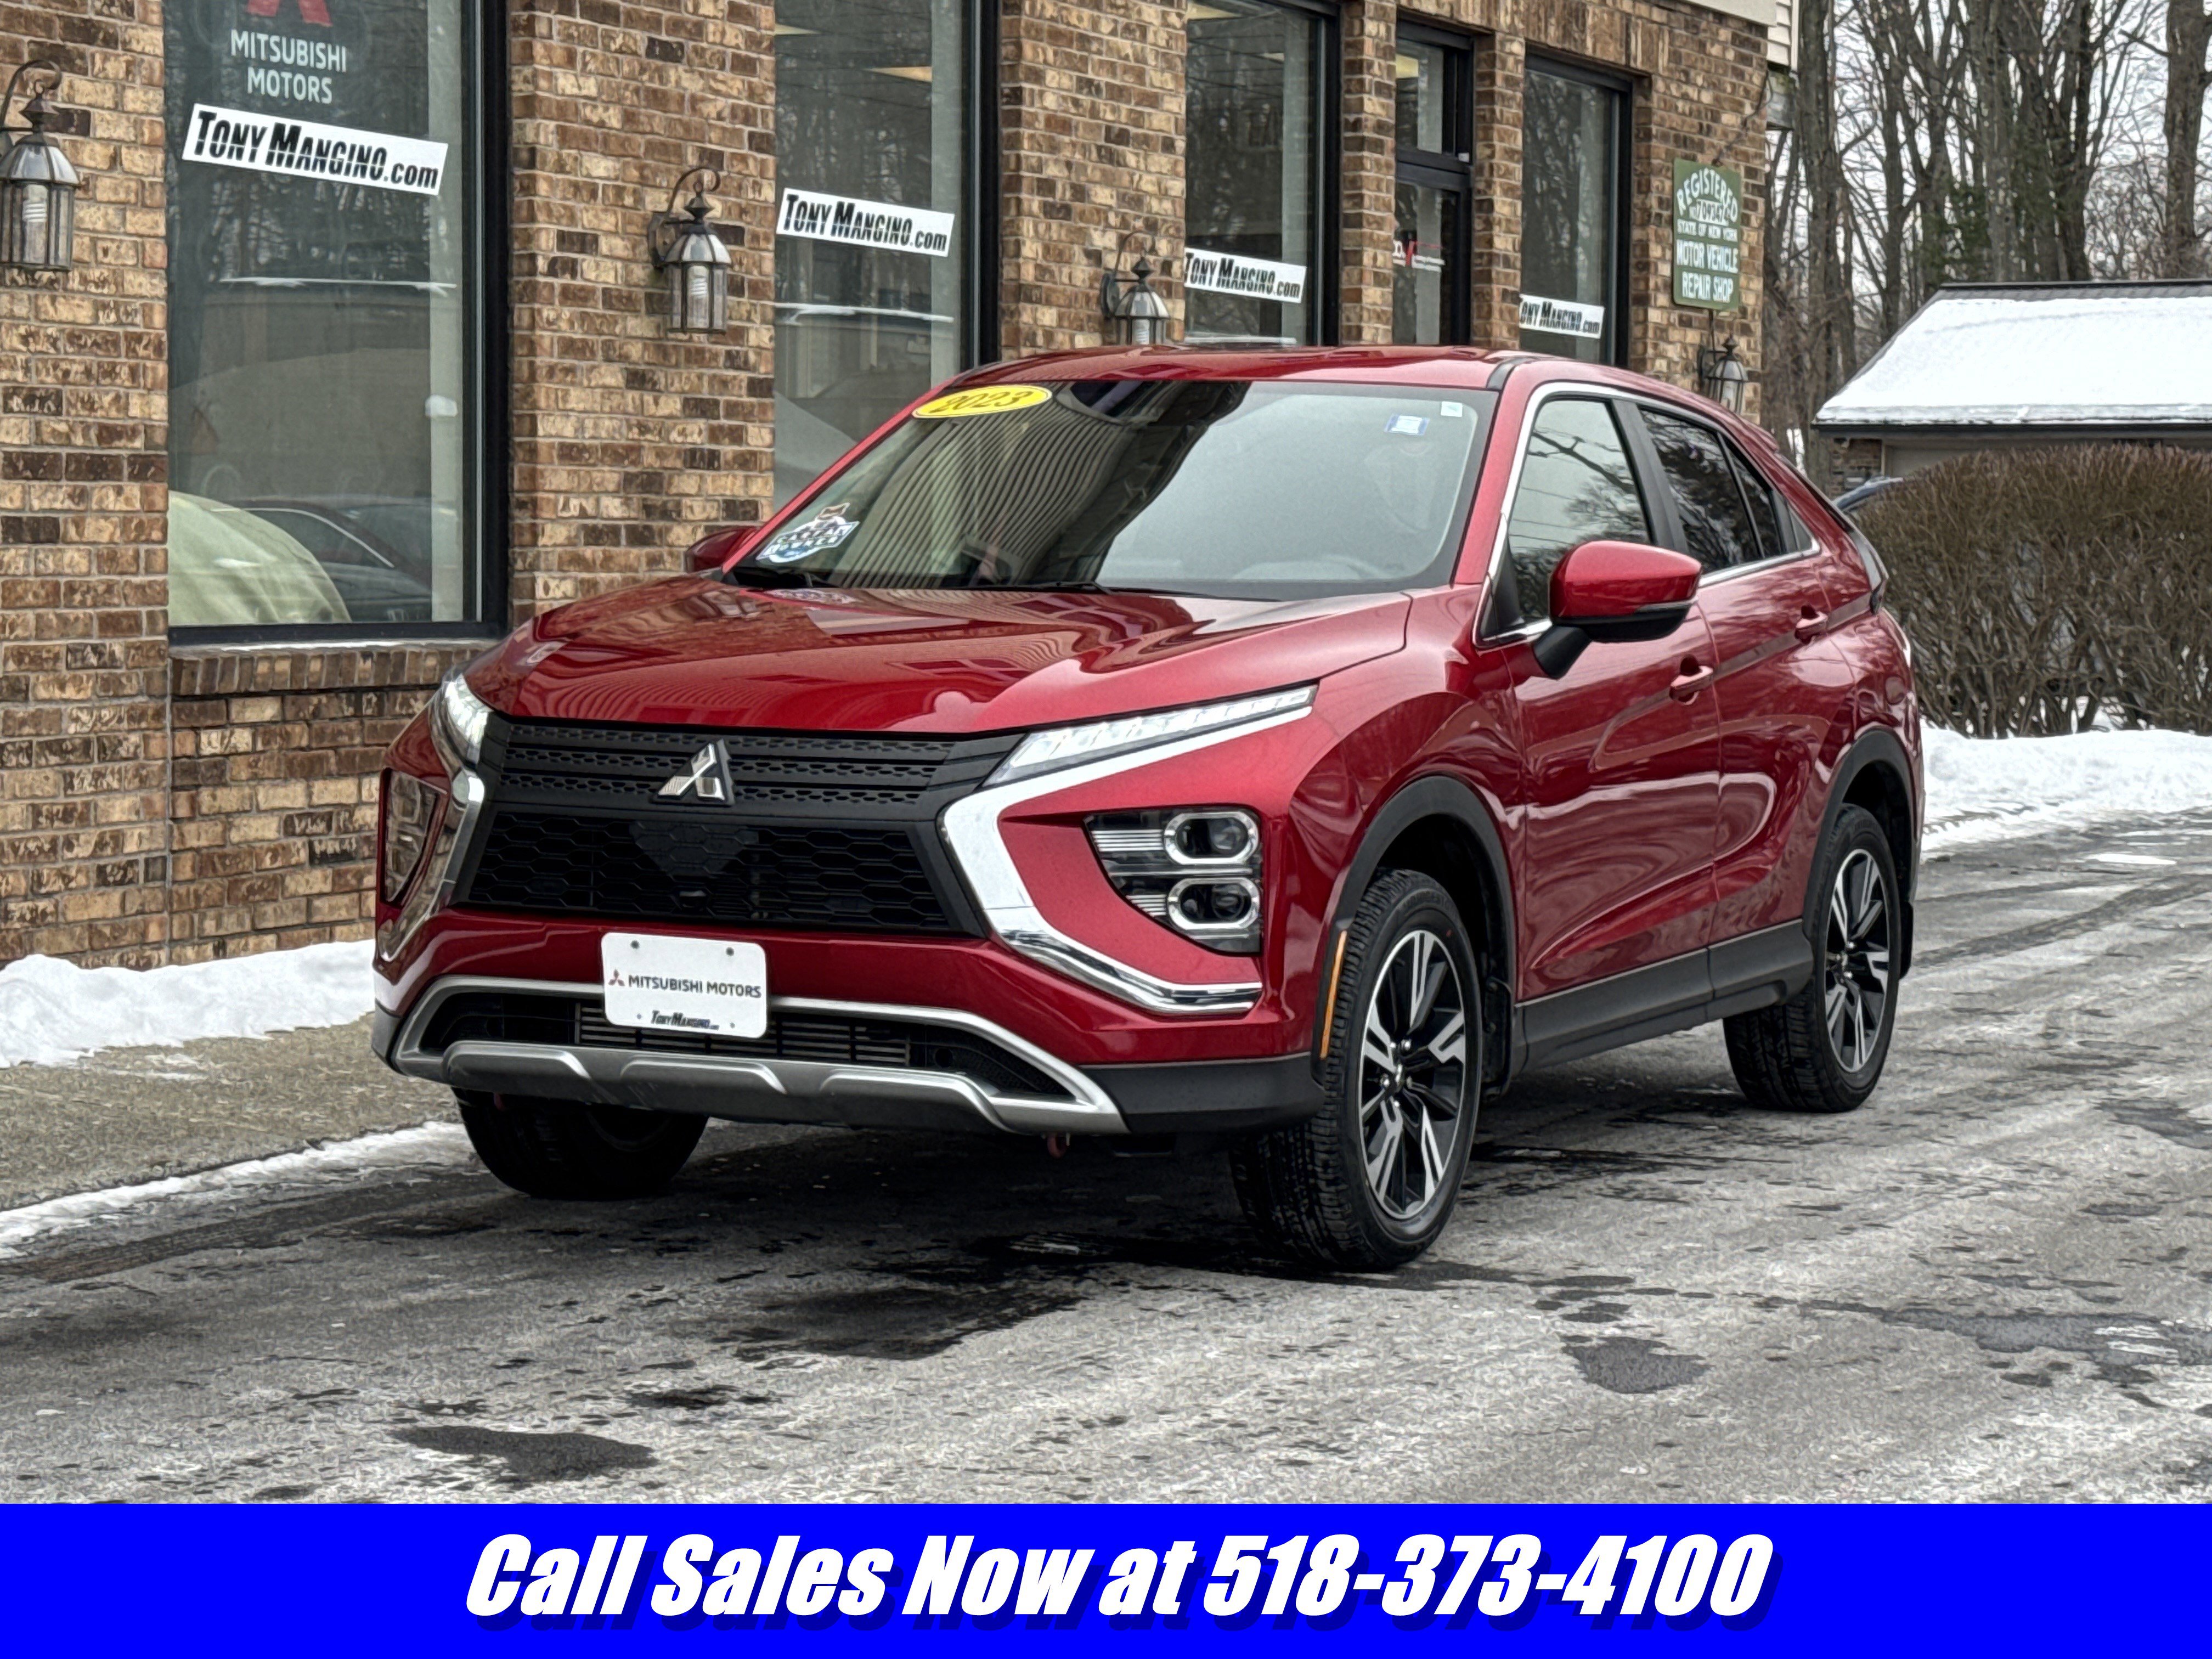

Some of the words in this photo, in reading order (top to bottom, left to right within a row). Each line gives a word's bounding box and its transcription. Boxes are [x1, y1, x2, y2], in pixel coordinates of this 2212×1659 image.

[230, 29, 347, 72] MITSUBISHI
[247, 67, 332, 104] MOTORS
[1677, 167, 1738, 222] REGISTERED
[1676, 239, 1705, 269] MOTOR
[1706, 243, 1739, 274] VEHICLE
[1682, 271, 1711, 301] REPAIR
[1713, 275, 1734, 303] SHOP
[1520, 301, 1541, 326] ONY
[928, 391, 1035, 413] 2023
[628, 974, 703, 994] MITSUBISHI
[707, 980, 761, 998] MOTORS
